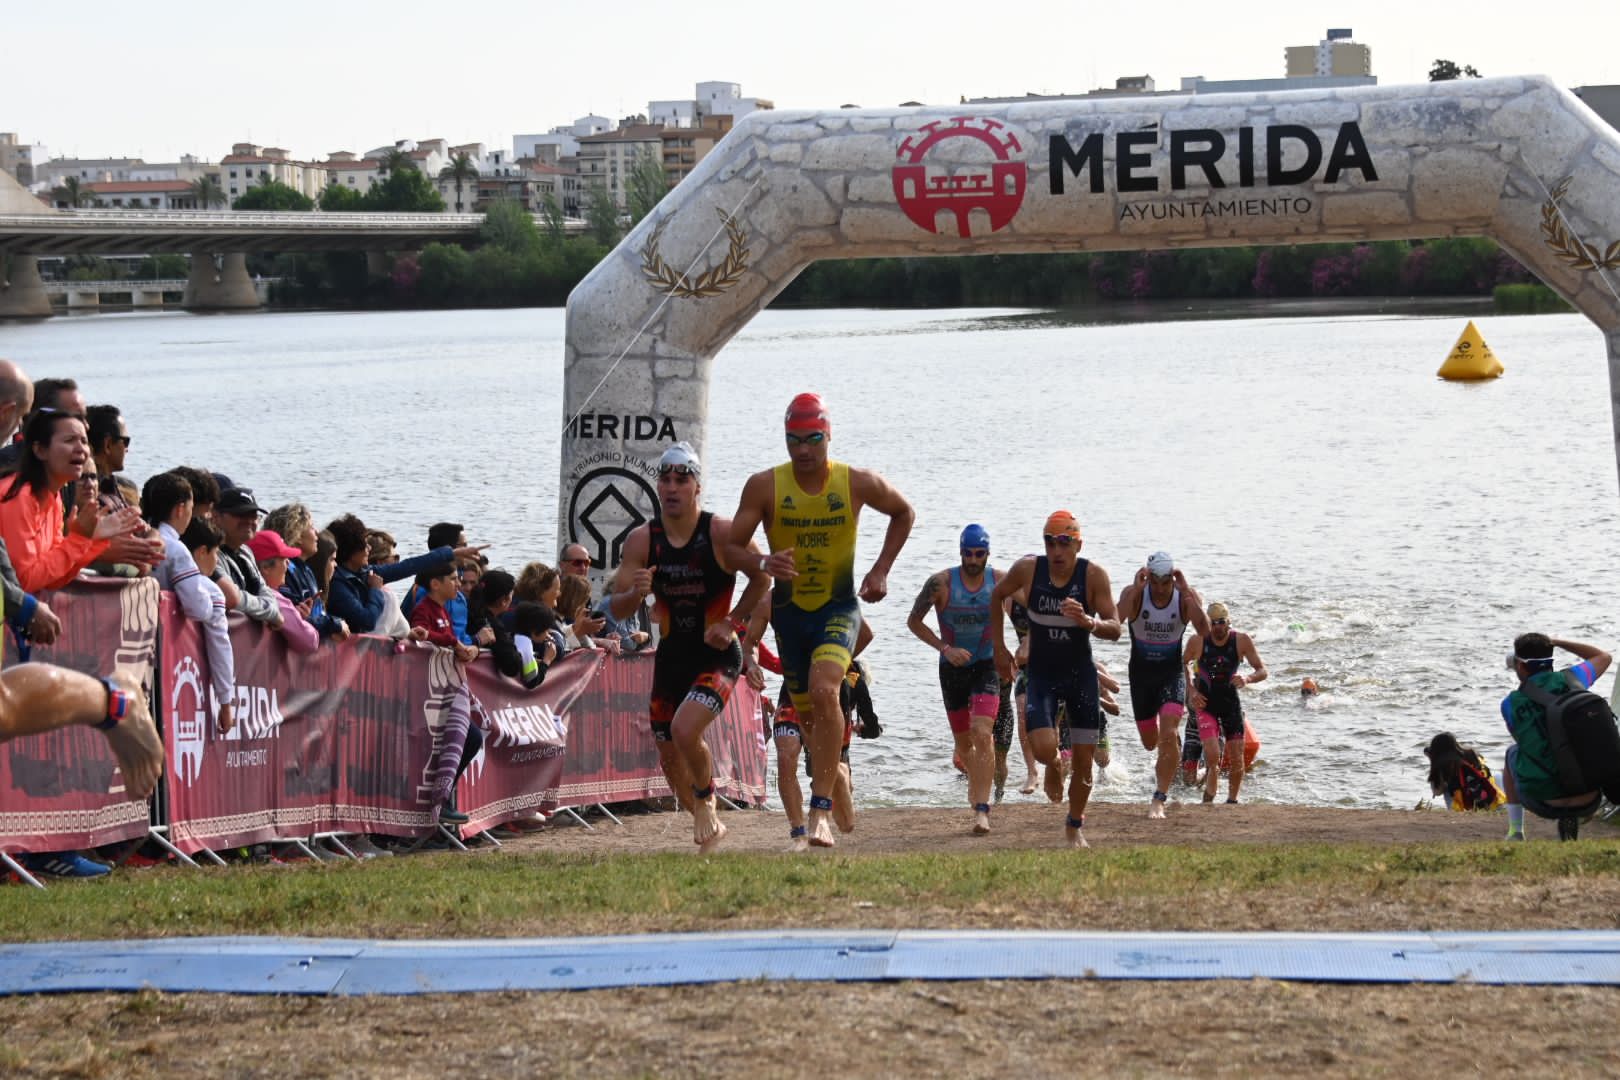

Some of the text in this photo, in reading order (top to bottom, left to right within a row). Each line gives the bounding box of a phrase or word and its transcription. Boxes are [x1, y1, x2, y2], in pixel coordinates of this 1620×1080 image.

[1049, 121, 1379, 195] MÉRIDA
[1119, 197, 1312, 221] AYUNTAMIENTO
[796, 532, 830, 548] NOBRE
